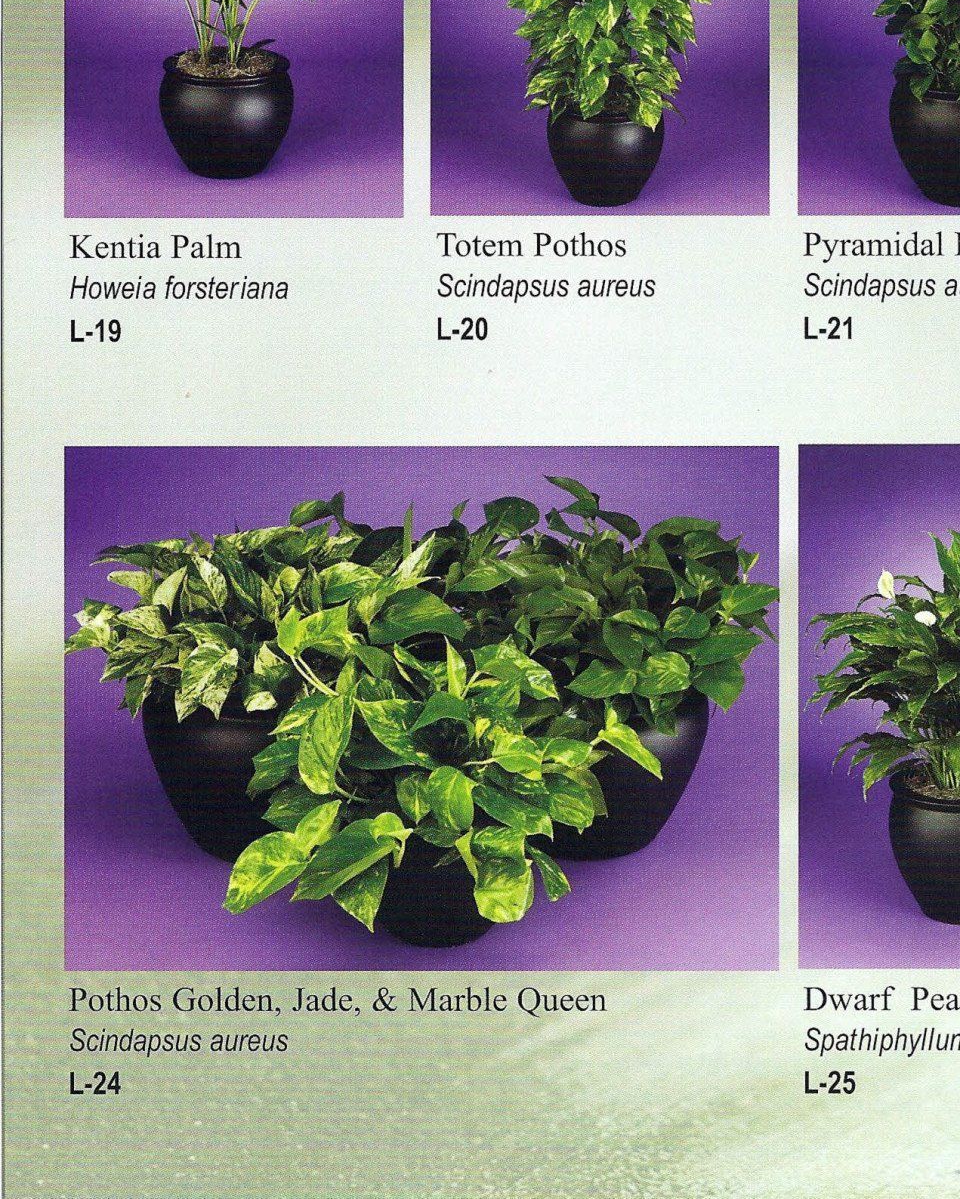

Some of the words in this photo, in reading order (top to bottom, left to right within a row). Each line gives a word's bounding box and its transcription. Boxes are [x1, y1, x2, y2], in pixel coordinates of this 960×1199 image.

[70, 233, 161, 260] Kentia
[172, 233, 242, 259] Palm
[436, 232, 523, 258] Totem
[534, 231, 627, 258] Pothos
[804, 231, 943, 264] Pyramidal
[69, 275, 157, 300] Howeia
[164, 274, 289, 300] forsteriana
[437, 272, 570, 304] Scindapsus
[577, 279, 656, 298] aureus
[803, 272, 936, 303] Scindapsus
[70, 318, 122, 343] L-19
[437, 316, 489, 341] L-20
[803, 316, 853, 340] L-21
[70, 986, 162, 1012] Pothos
[172, 986, 281, 1016] Golden,
[292, 986, 361, 1015] Jade,
[372, 986, 397, 1012] &
[409, 986, 507, 1012] Marble
[517, 987, 606, 1017] Queen
[804, 985, 896, 1011] Dwarf
[69, 1027, 202, 1058] Scindapsus
[210, 1033, 289, 1052] aureus
[69, 1071, 122, 1095] L-24
[804, 1070, 856, 1095] L-25
